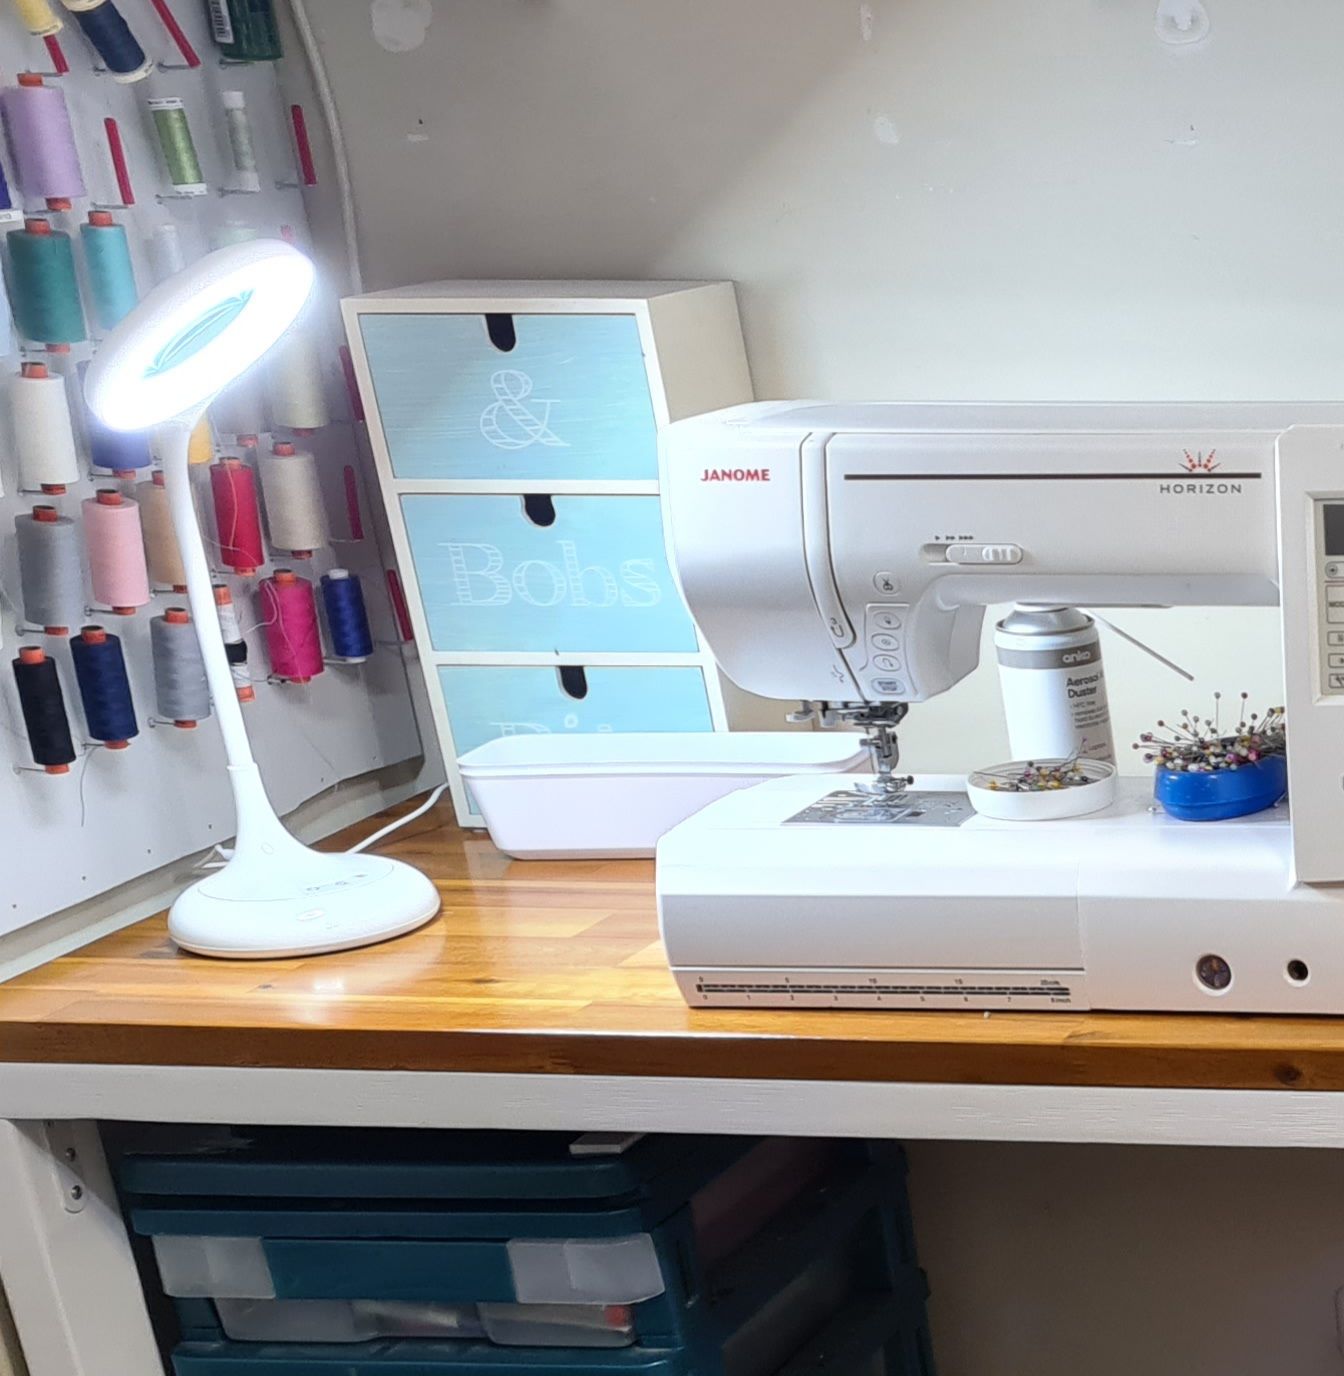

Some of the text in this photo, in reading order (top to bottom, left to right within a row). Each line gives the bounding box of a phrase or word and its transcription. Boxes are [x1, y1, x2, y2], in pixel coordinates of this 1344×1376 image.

[700, 468, 770, 482] JANOME
[1159, 484, 1242, 494] HORIZON
[437, 539, 662, 607] Bobs
[1062, 651, 1091, 663] anko
[1066, 674, 1099, 688] Aerosol
[1067, 686, 1097, 699] Duster
